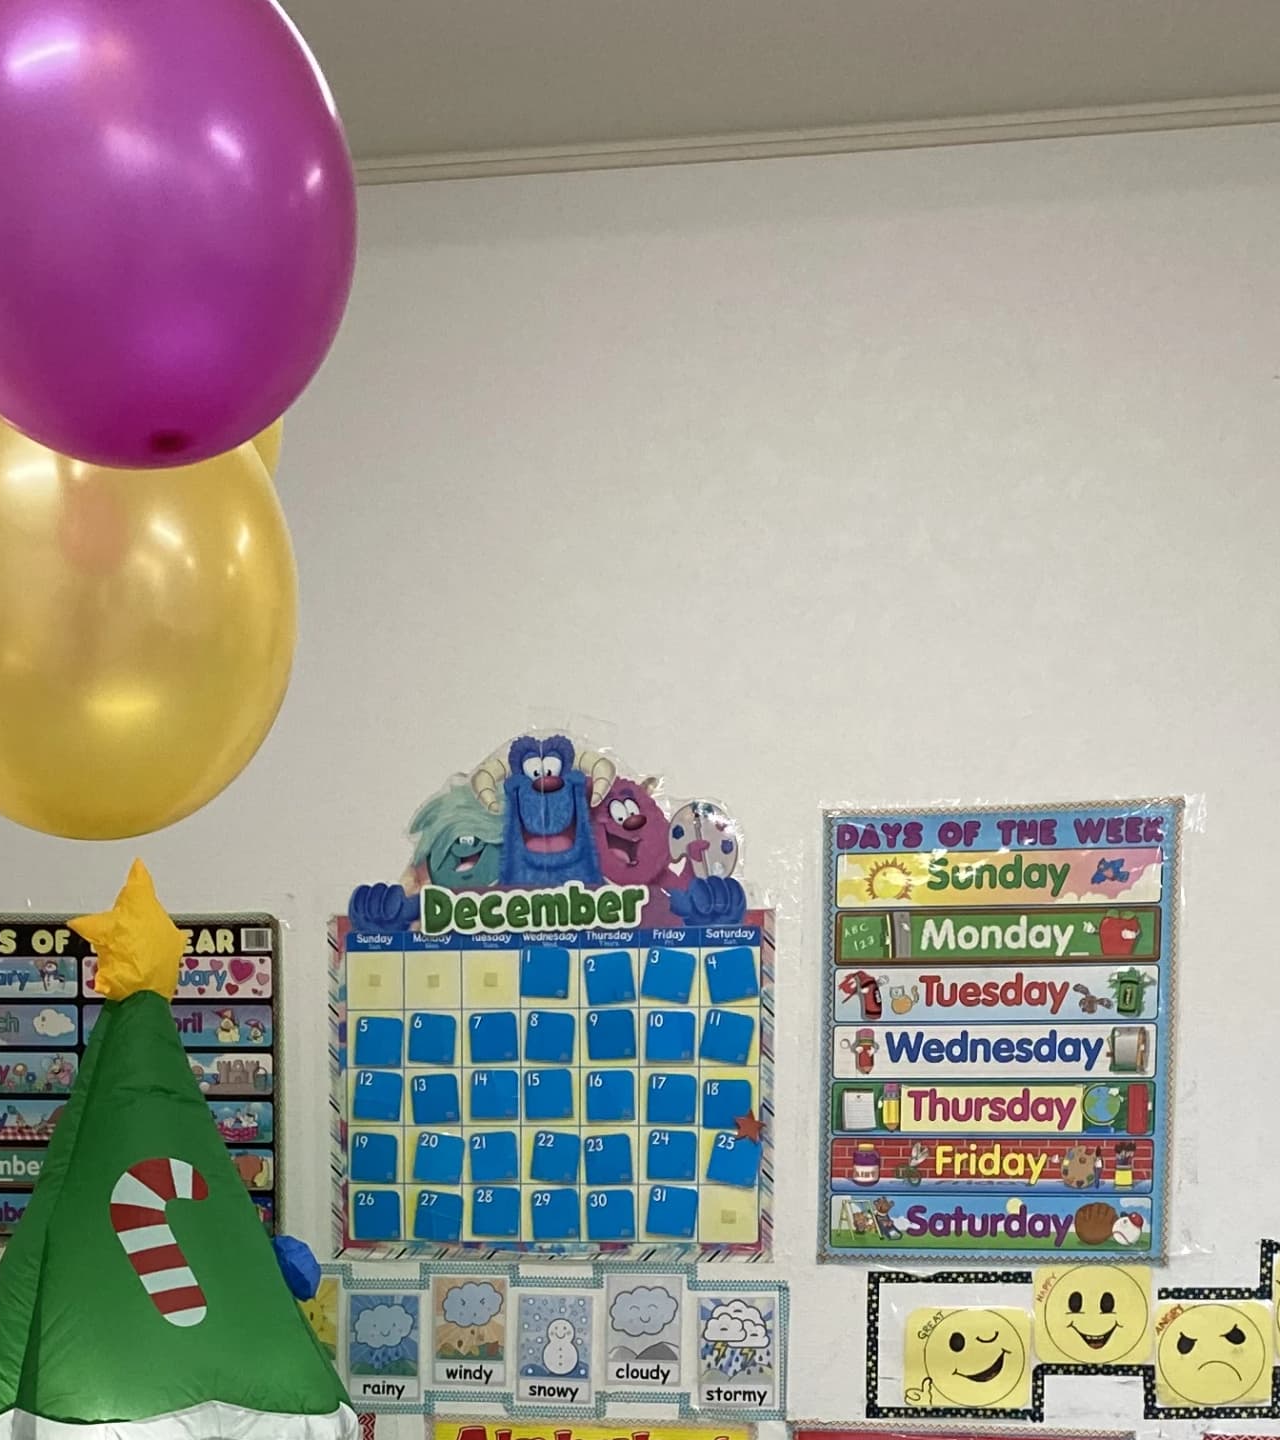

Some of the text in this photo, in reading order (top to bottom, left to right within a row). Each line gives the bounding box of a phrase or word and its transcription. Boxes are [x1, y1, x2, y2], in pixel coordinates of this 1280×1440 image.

[836, 817, 1163, 849] DAYS OF THE WEEK
[926, 854, 1070, 896] Sunday
[423, 886, 645, 932] December
[356, 933, 393, 945] Sunday
[585, 929, 633, 942] Thursday
[652, 929, 686, 942] Friday
[705, 928, 755, 941] Saturday
[843, 924, 869, 939] ABC
[920, 916, 1075, 956] Monday
[31, 930, 70, 954] OF
[650, 951, 659, 963] 3
[707, 956, 717, 969] 4
[918, 972, 1070, 1014] Tuesday
[650, 1014, 663, 1028] 10
[885, 1030, 1104, 1071] Wednesday
[359, 1072, 373, 1085] 12
[589, 1074, 602, 1087] 16
[906, 1087, 1076, 1130] Thursday
[421, 1134, 438, 1147] 20
[652, 1133, 669, 1146] 24
[934, 1144, 1048, 1184] Friday
[534, 1194, 550, 1206] 29
[905, 1203, 1073, 1247] Saturday
[1034, 1271, 1058, 1303] HAPPY
[917, 1310, 946, 1342] GREAT
[1154, 1304, 1185, 1337] ANGRY
[445, 1365, 493, 1383] windy
[615, 1365, 671, 1384] cloudy
[362, 1381, 406, 1399] rainy
[528, 1384, 579, 1402] snowy
[705, 1386, 768, 1406] stormy
